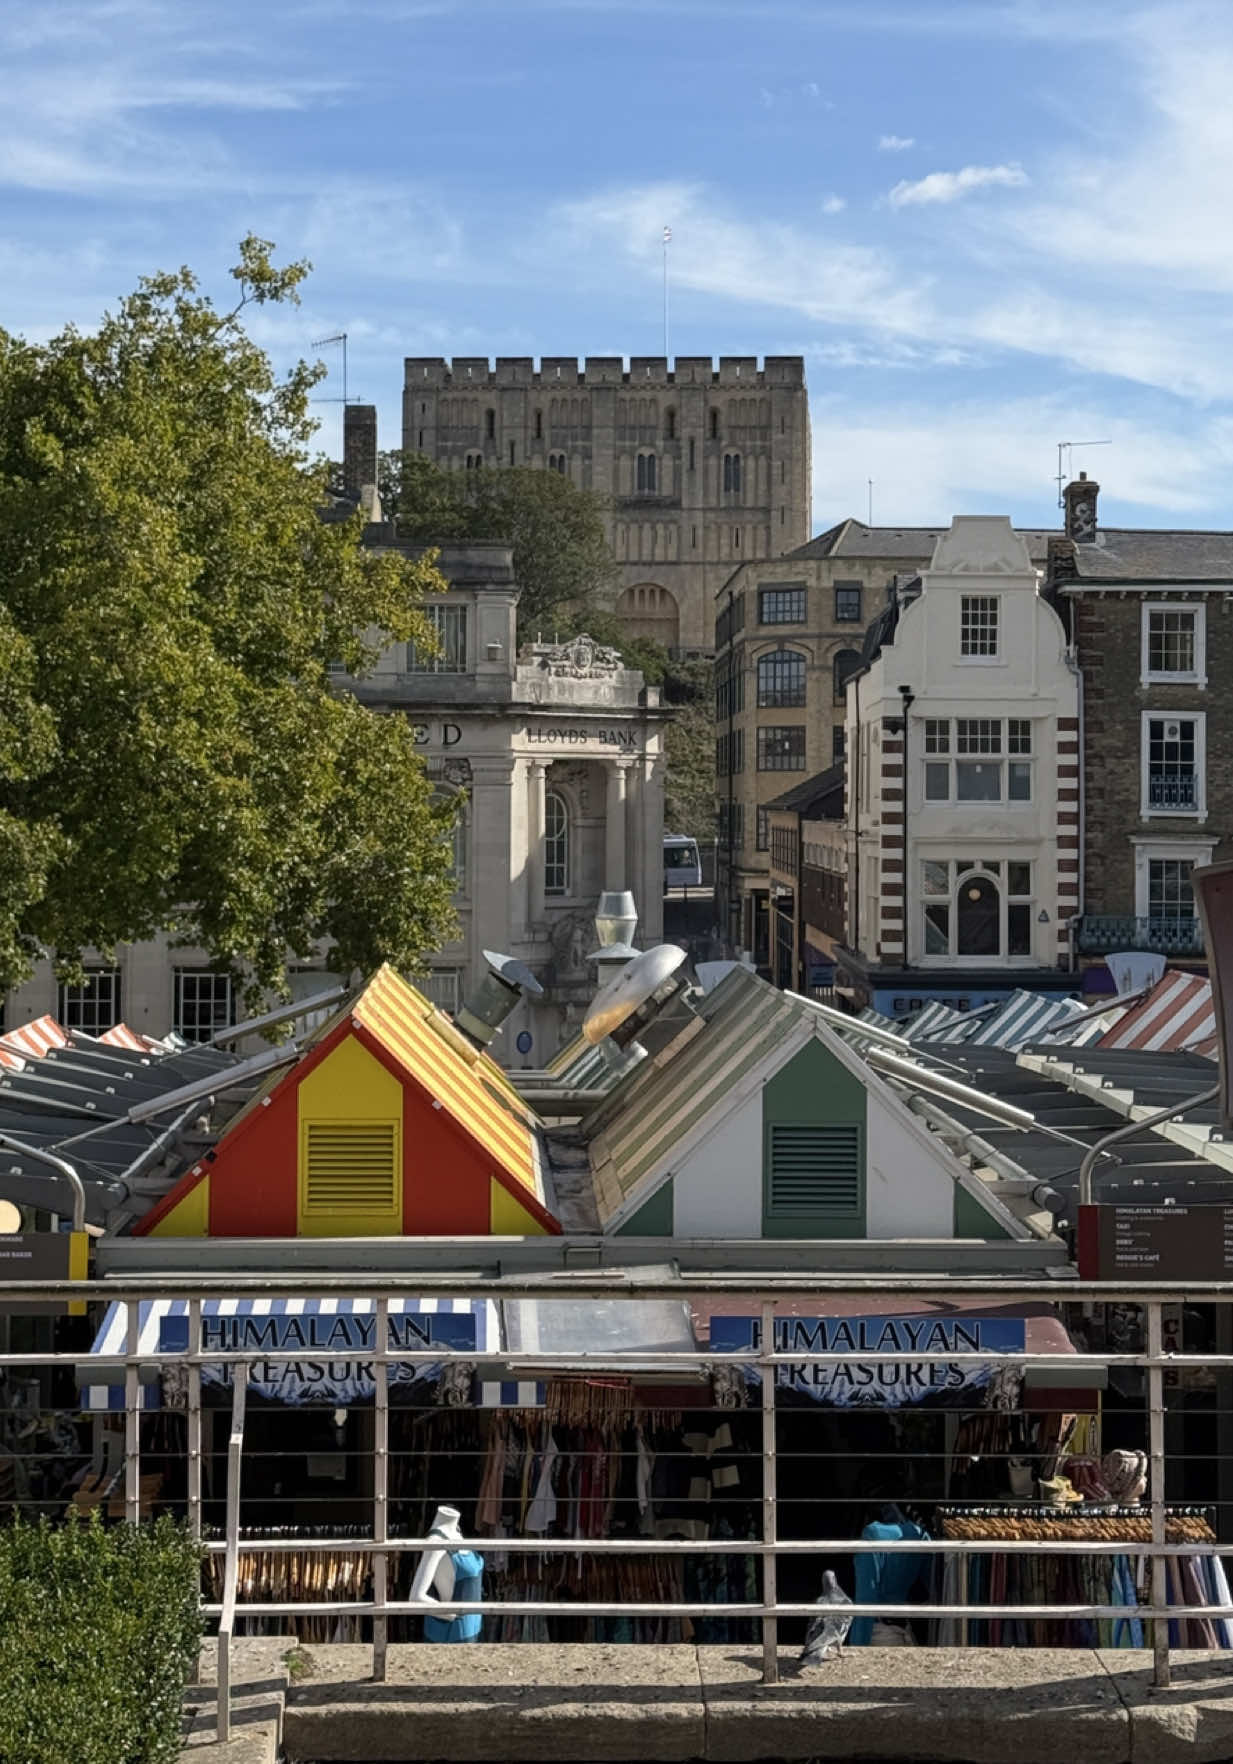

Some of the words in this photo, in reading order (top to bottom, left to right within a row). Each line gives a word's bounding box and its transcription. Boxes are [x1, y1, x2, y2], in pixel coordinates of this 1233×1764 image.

[527, 727, 589, 745] LLOYDS
[598, 729, 638, 746] BANK
[201, 1316, 432, 1348] HIMALAYAN
[751, 1319, 981, 1352] HIMALAYAN
[1163, 1319, 1179, 1386] CAS
